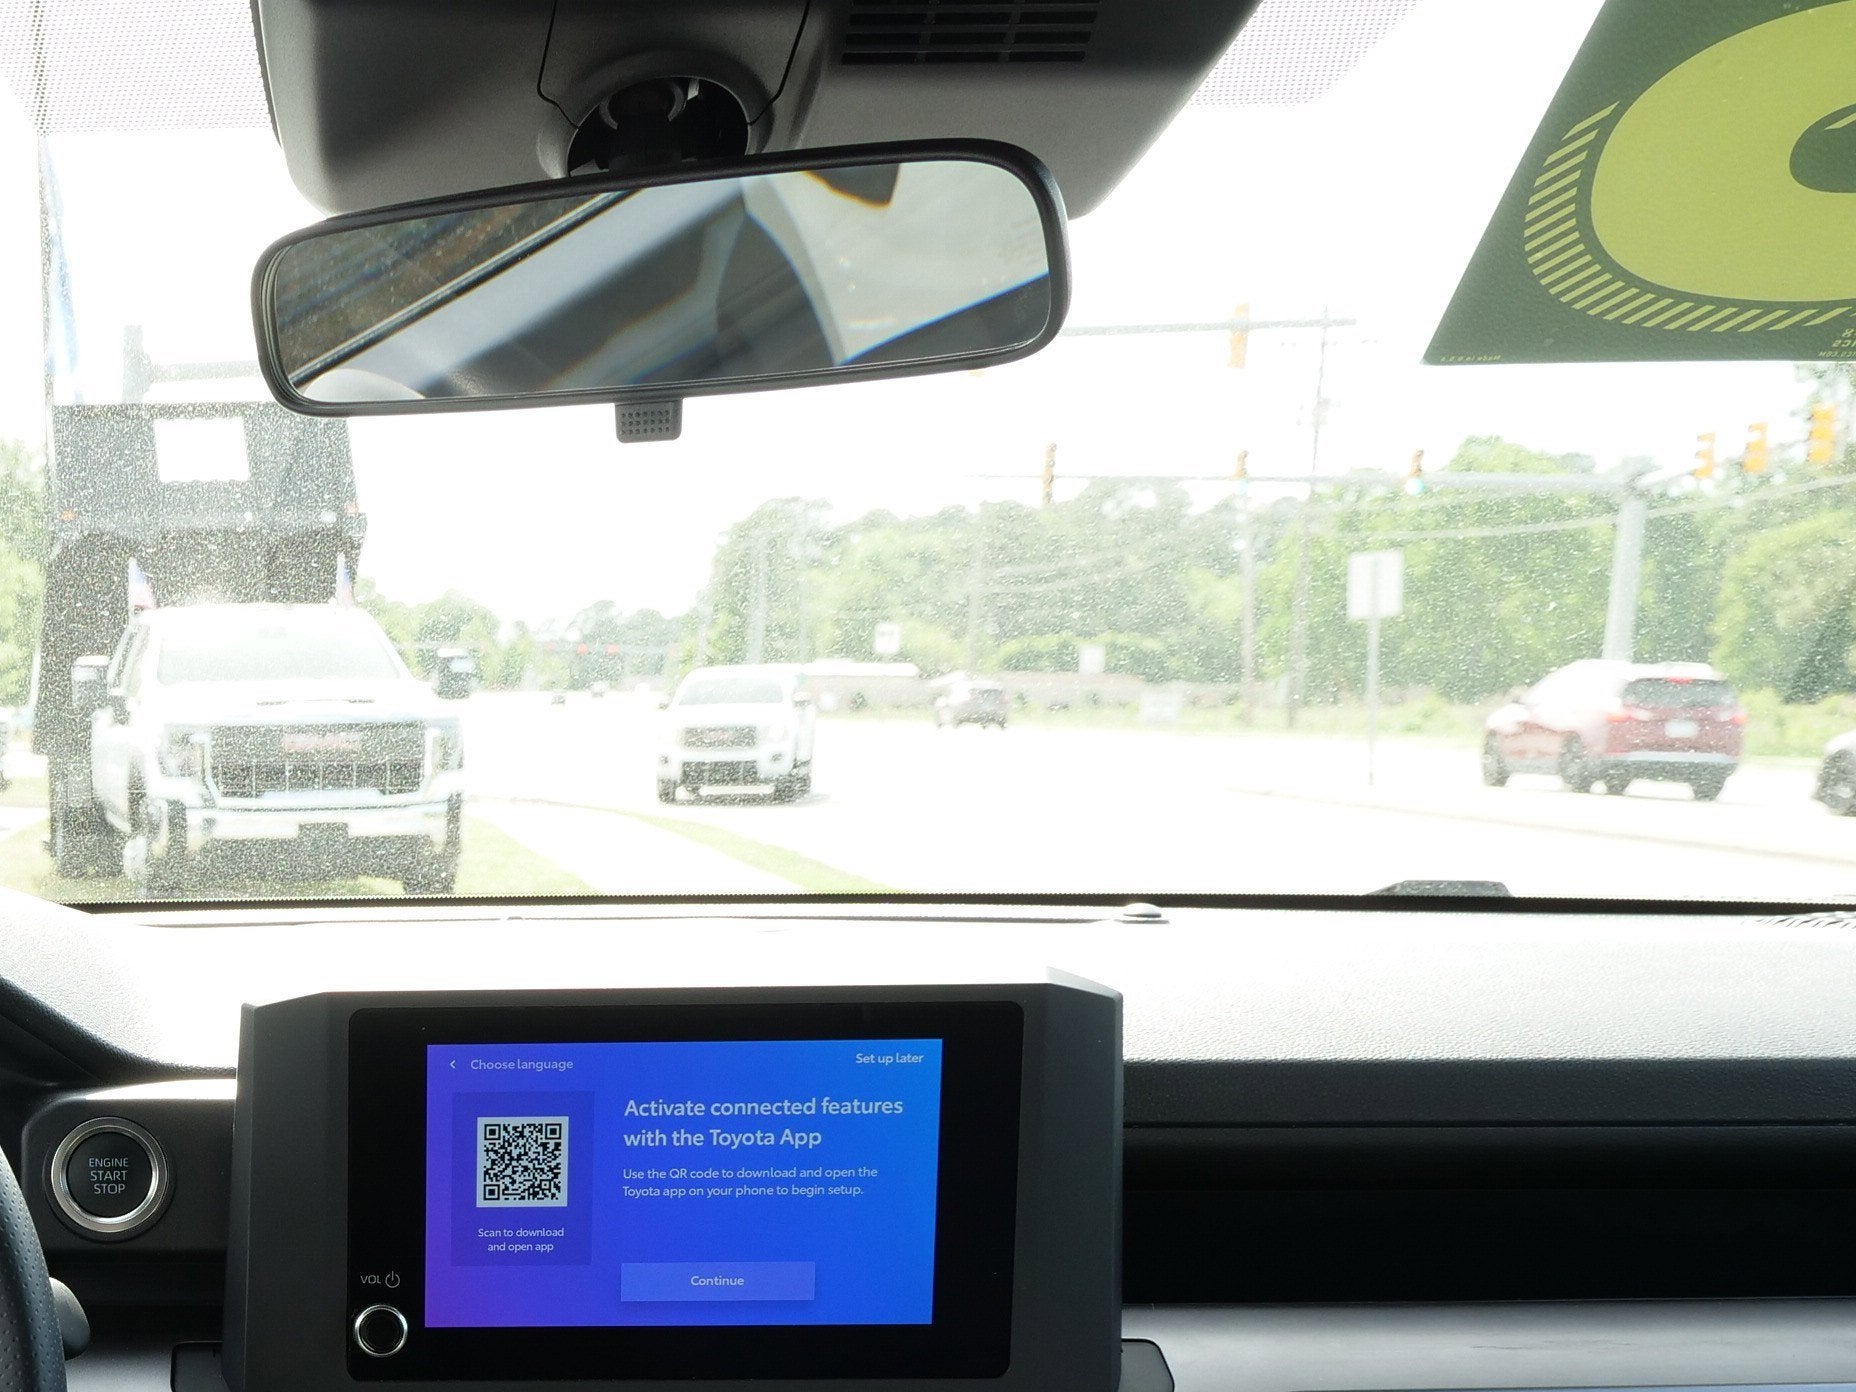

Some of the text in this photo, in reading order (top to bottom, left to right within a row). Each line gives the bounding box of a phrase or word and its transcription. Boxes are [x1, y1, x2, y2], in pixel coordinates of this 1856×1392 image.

[470, 1058, 573, 1071] Choose language
[855, 1052, 924, 1066] Set up later
[623, 1097, 903, 1117] Activate connected features
[623, 1128, 822, 1149] with the Toyota App
[88, 1158, 129, 1167] ENGINE
[90, 1170, 127, 1181] START
[623, 1167, 878, 1180] Use the QR code to download and open the
[94, 1183, 125, 1194] STOP
[622, 1184, 864, 1199] Toyota app on your phone to begin setup.
[478, 1227, 565, 1237] Scan to download
[487, 1243, 554, 1253] and open app
[360, 1275, 381, 1285] VOL
[690, 1274, 744, 1287] Continue
